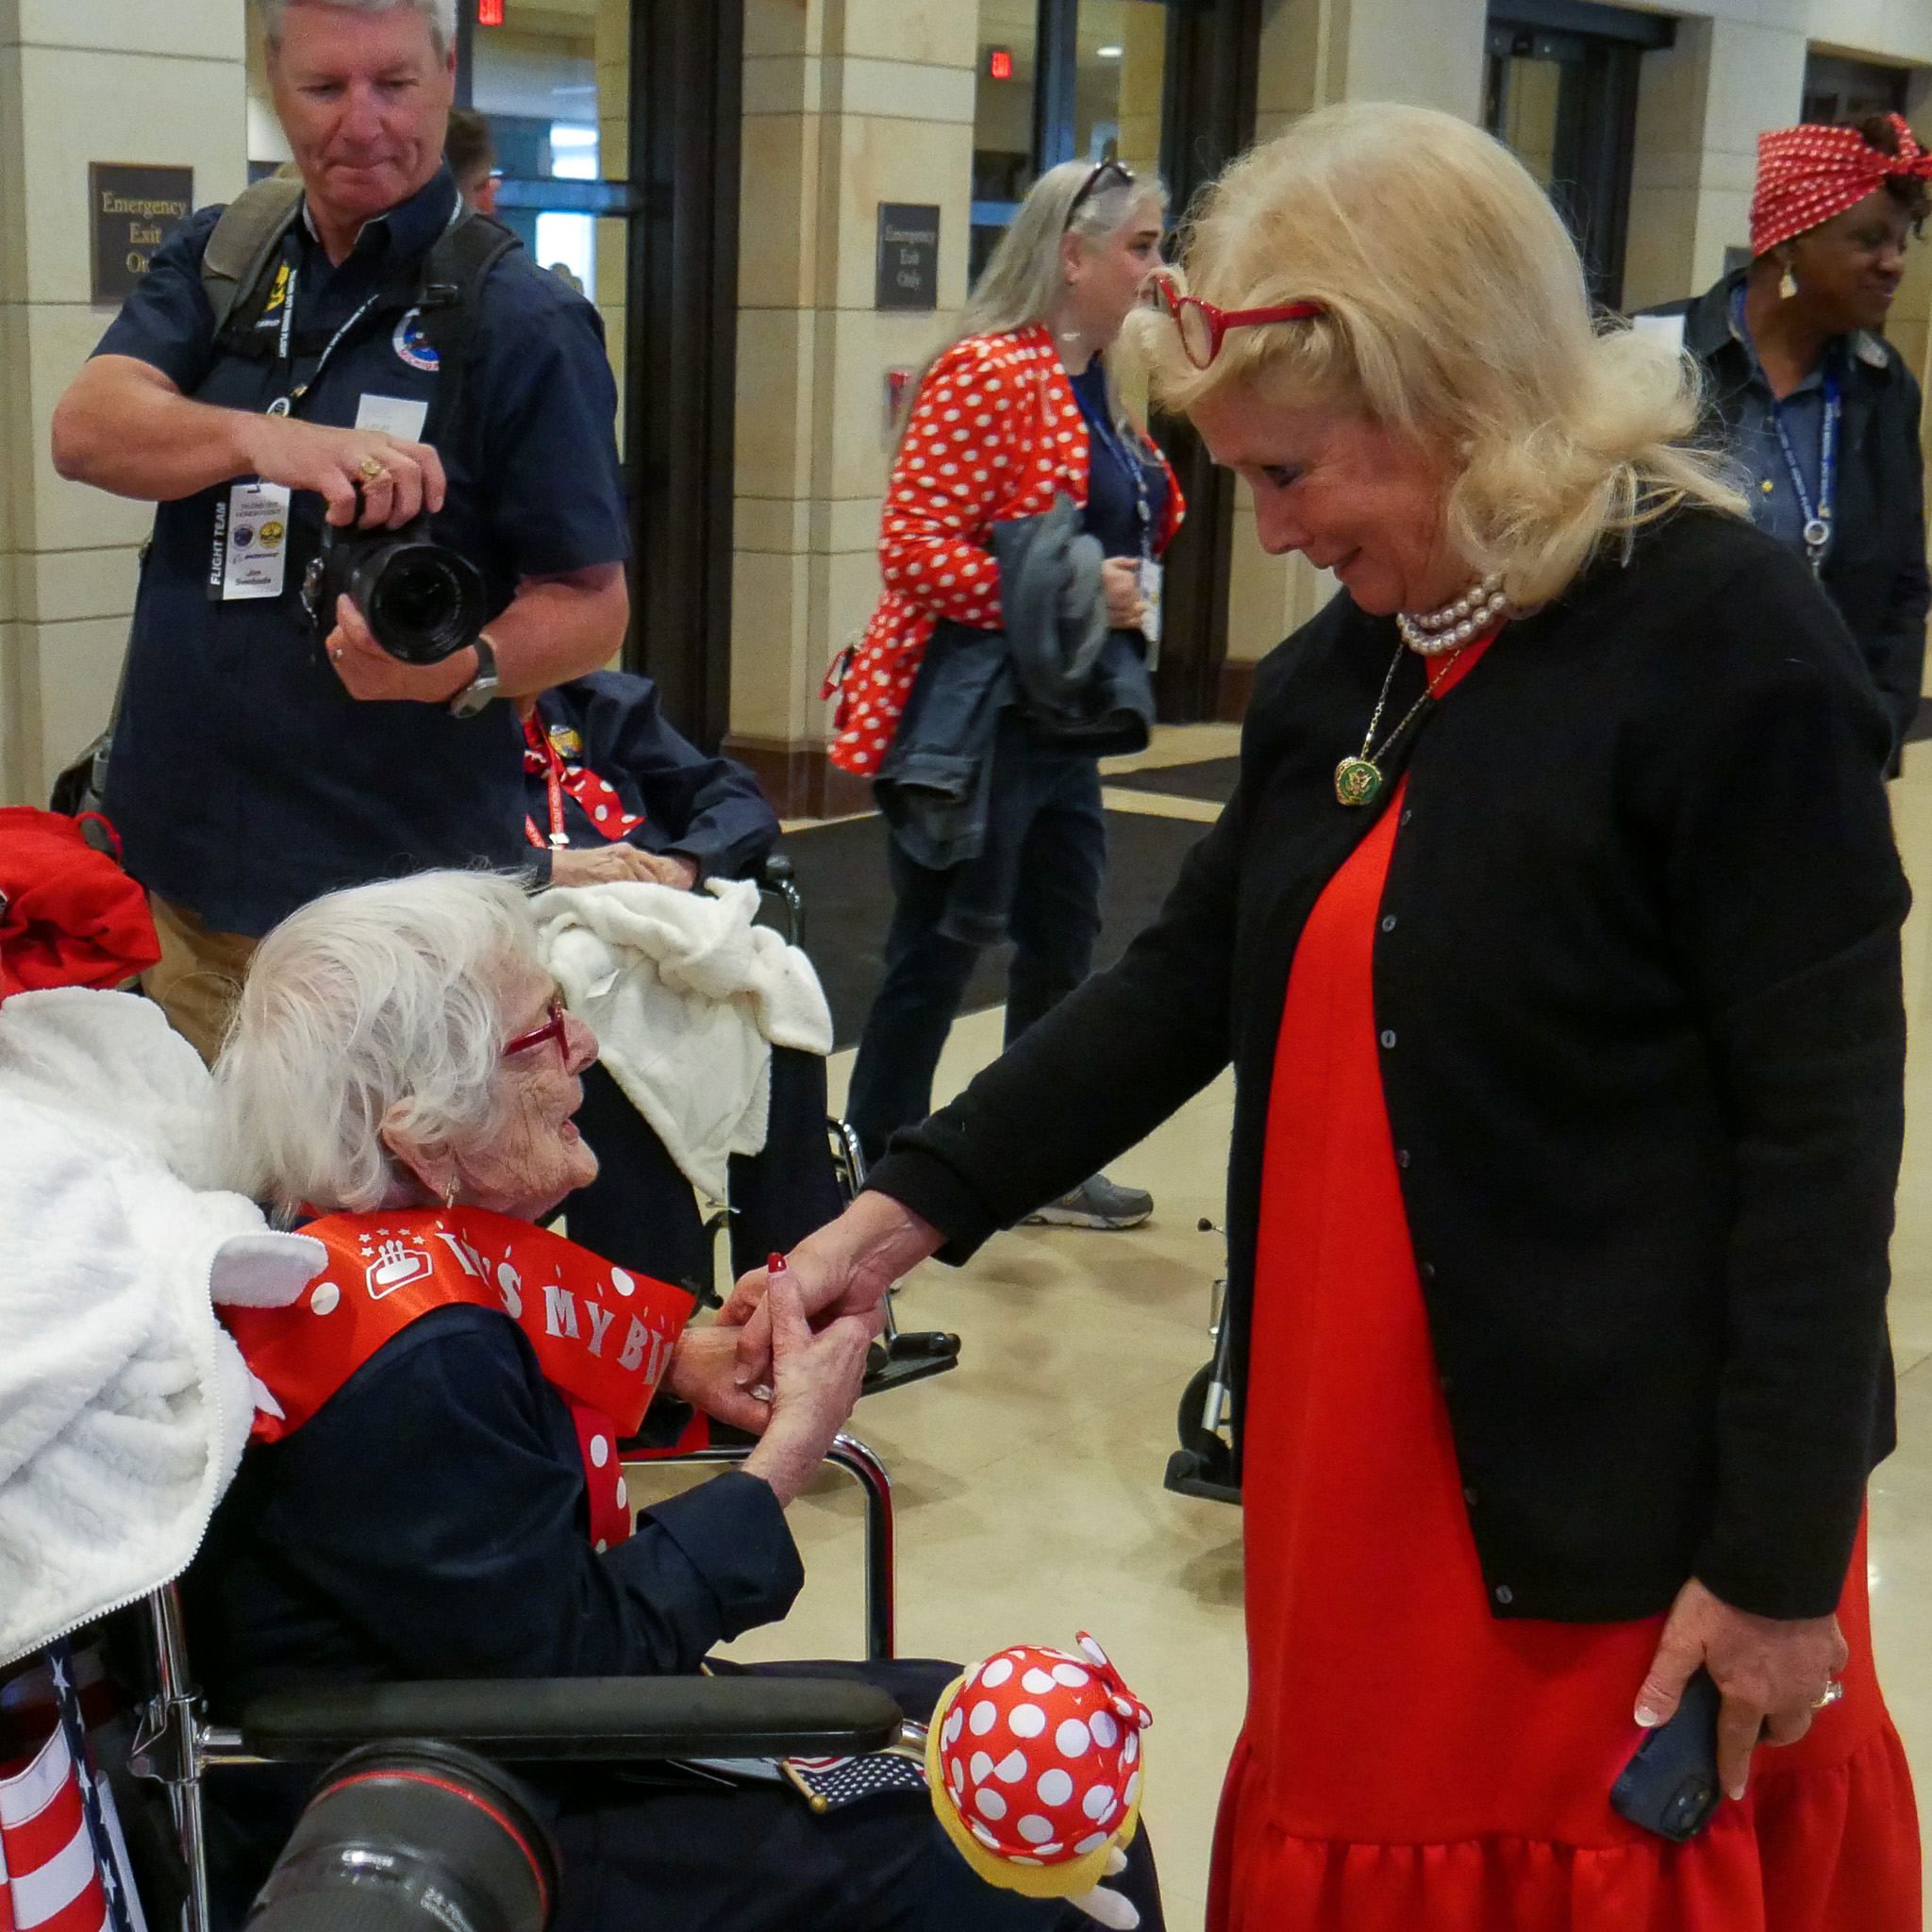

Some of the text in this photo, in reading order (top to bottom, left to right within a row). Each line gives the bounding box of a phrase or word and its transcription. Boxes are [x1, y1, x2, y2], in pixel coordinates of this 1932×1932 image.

[102, 192, 187, 219] Emergency
[129, 222, 161, 244] Exit
[125, 252, 149, 273] On
[210, 501, 226, 586] FLIGHT TEAM
[541, 1285, 616, 1358] MY
